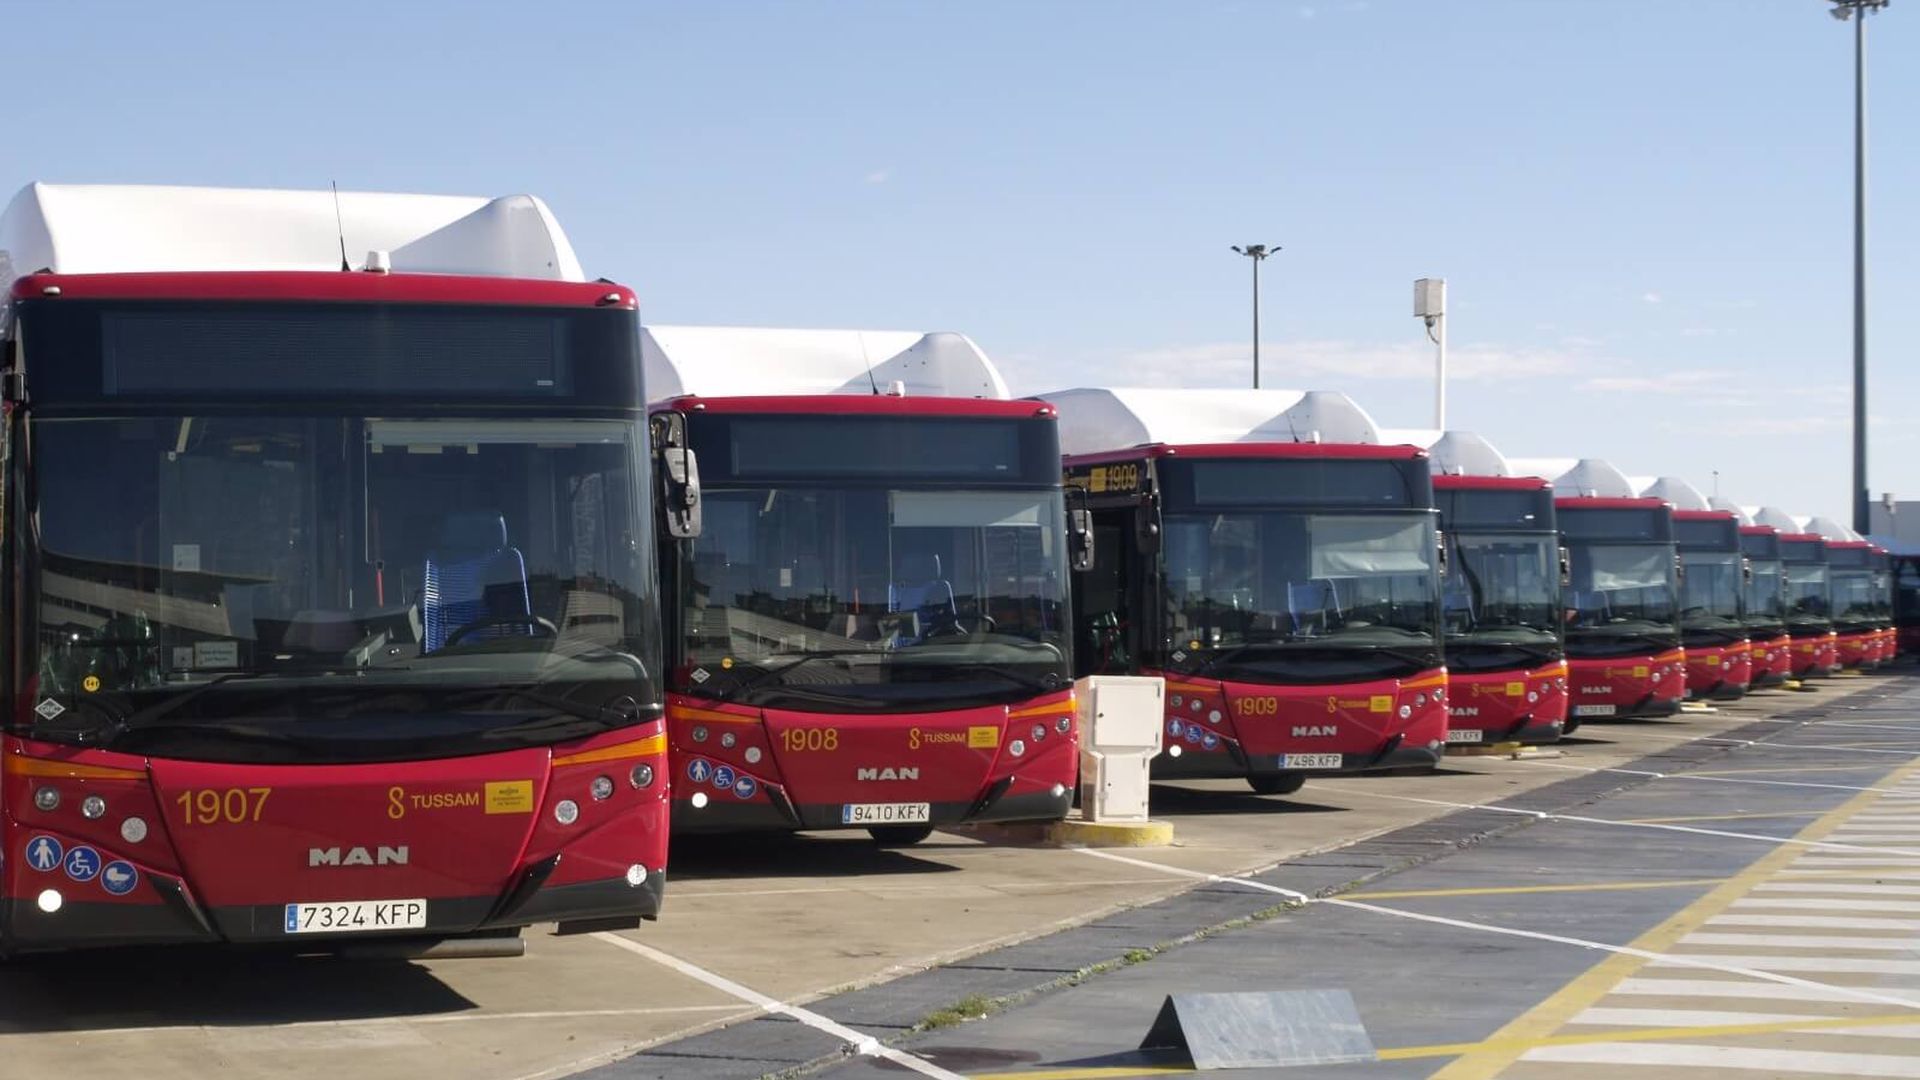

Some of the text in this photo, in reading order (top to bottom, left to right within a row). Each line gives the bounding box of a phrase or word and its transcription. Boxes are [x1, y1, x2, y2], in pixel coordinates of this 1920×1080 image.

[1107, 464, 1137, 491] 1909
[1236, 697, 1277, 715] 1909
[780, 728, 838, 751] 1908
[923, 733, 966, 744] TUSSAM
[1292, 725, 1337, 737] MAN
[1287, 754, 1341, 767] 7496 KFP
[858, 768, 919, 780] MAN
[177, 787, 271, 824] 1907
[411, 792, 480, 809] TUSSAM
[854, 804, 926, 820] 9410 KFK
[309, 846, 409, 867] MAN
[304, 903, 420, 928] 7324 KFP
